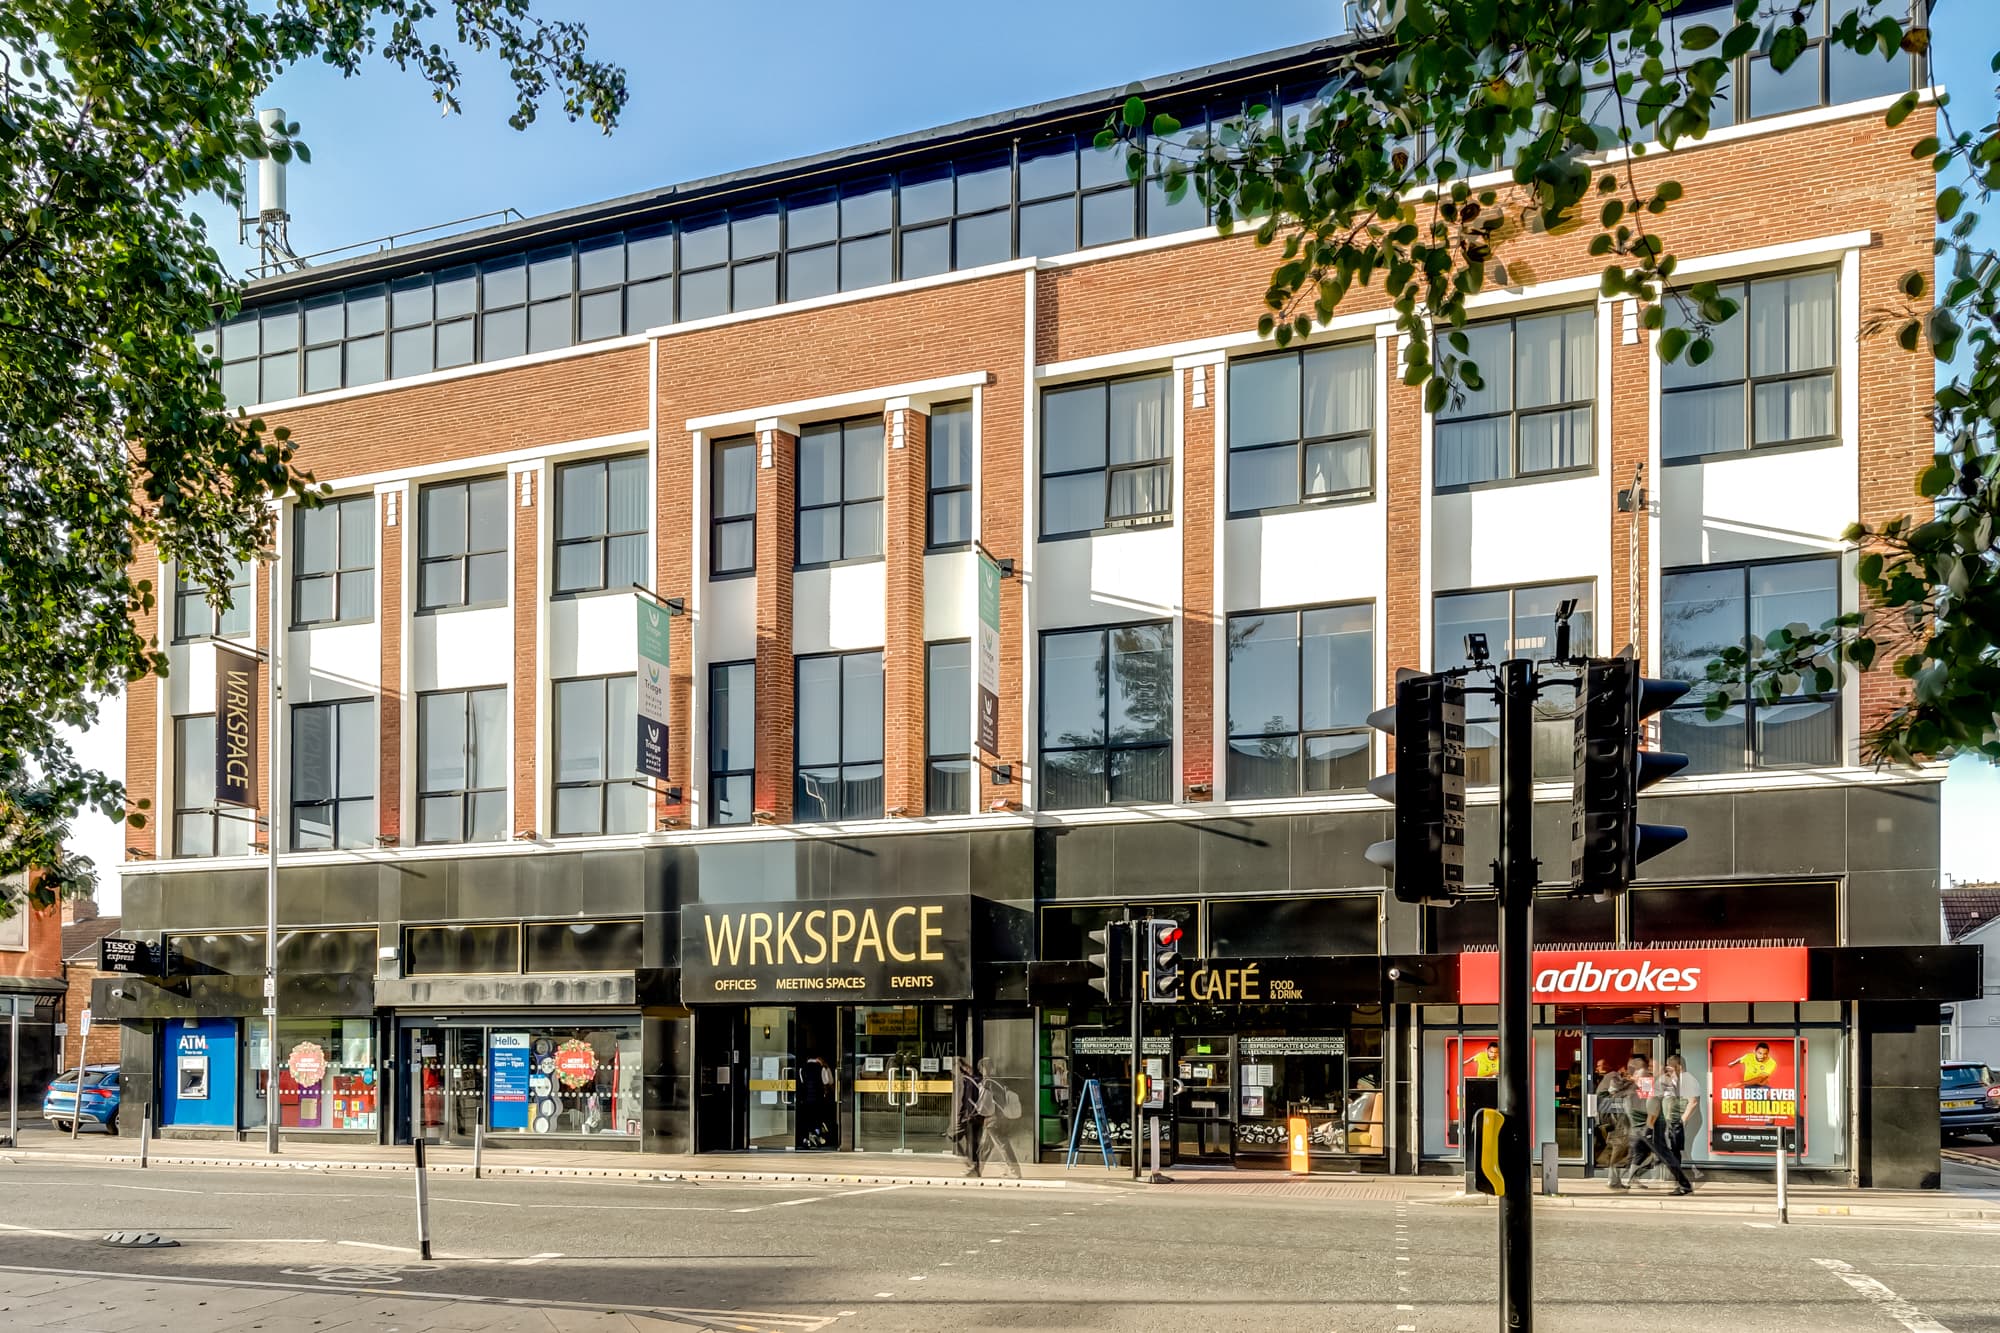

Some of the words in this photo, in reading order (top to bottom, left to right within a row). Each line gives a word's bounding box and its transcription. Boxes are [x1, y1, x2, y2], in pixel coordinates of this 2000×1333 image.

[226, 670, 249, 789] WRKSPACE
[704, 905, 944, 966] WRKSPACE
[105, 941, 136, 951] TESCO
[891, 976, 934, 988] EVENTS
[1190, 962, 1261, 1000] CAFÉ
[1532, 960, 1701, 993] adbrokes
[715, 978, 757, 991] OFFICES
[776, 977, 824, 990] MEETING
[825, 977, 866, 989] SPACES
[1270, 980, 1294, 990] FOOD
[1270, 990, 1277, 999] &
[1277, 990, 1303, 999] DRINK
[495, 1036, 521, 1046] Hello.
[1721, 1087, 1742, 1100] OUR
[1744, 1087, 1769, 1100] BEST
[1770, 1088, 1795, 1100] EVER
[1721, 1100, 1743, 1114] BET
[1745, 1100, 1795, 1115] BUILDER
